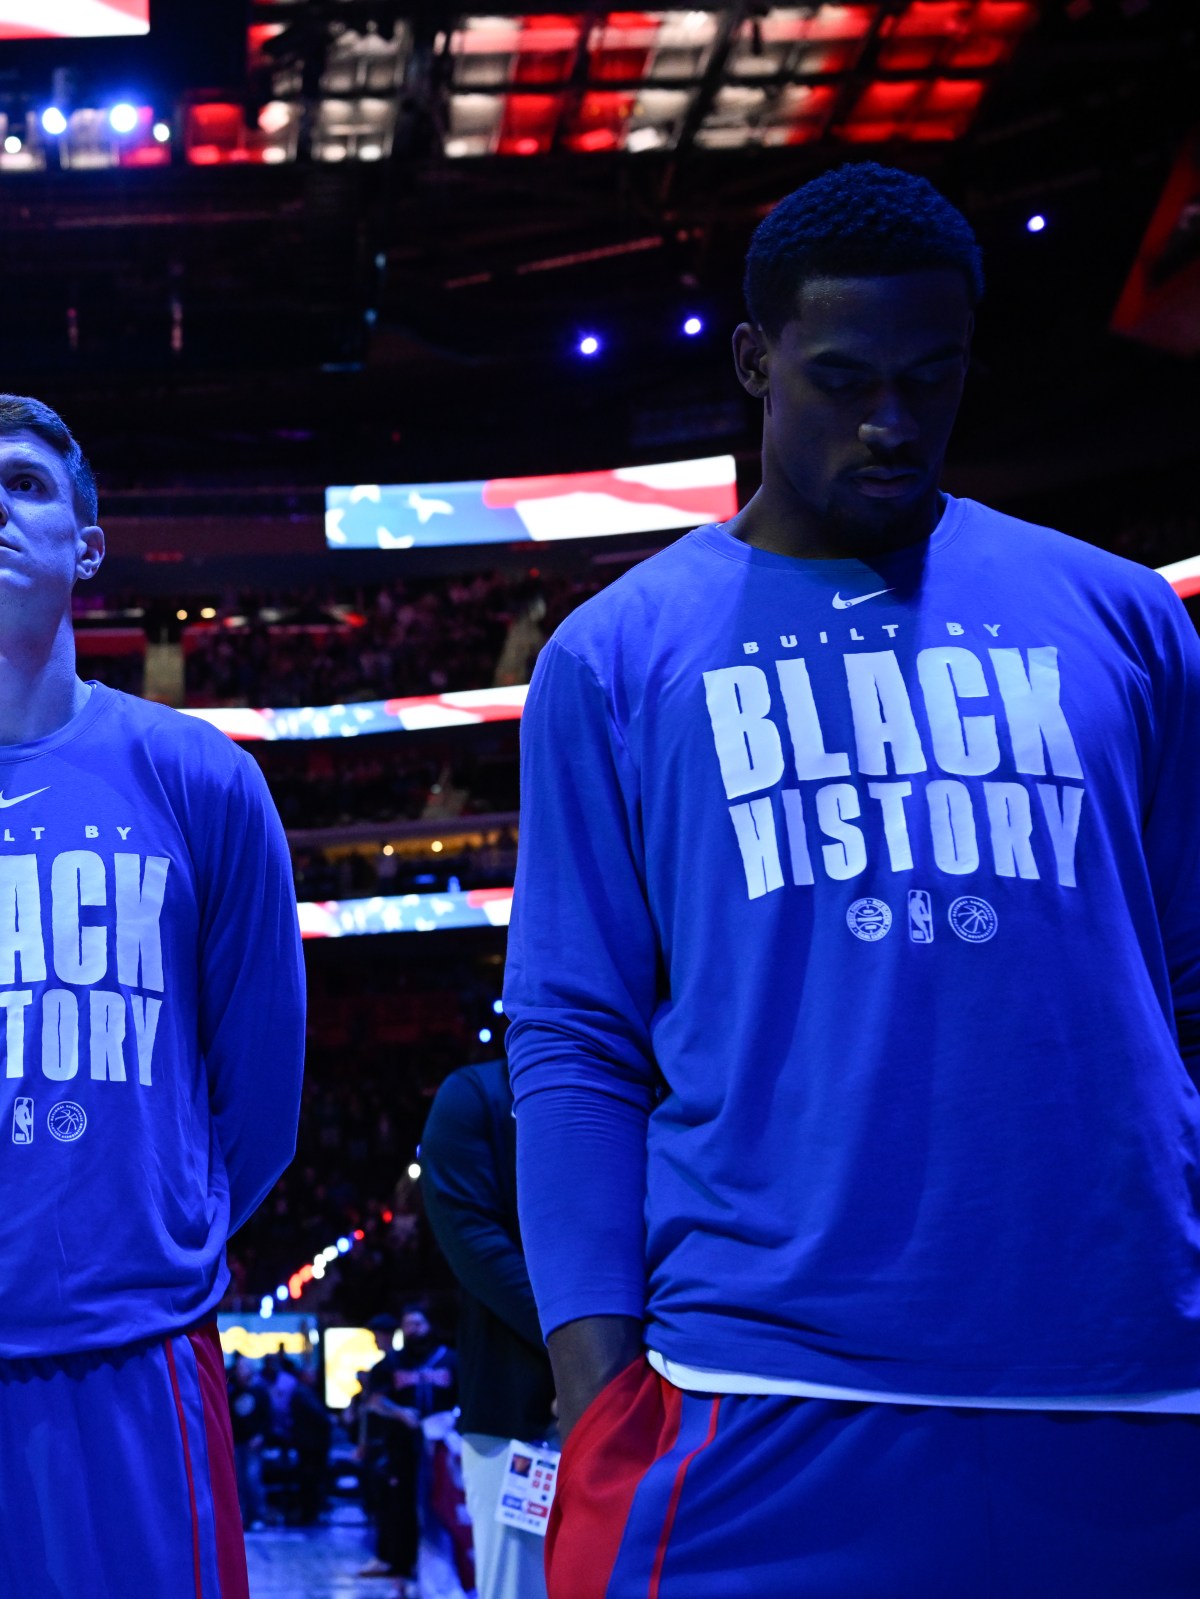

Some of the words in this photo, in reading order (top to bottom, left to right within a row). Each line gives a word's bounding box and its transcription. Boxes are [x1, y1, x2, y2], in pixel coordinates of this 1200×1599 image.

[742, 624, 899, 654] BUILT
[946, 621, 1001, 638] BY
[702, 646, 1085, 800] BLACK
[84, 825, 132, 841] BY
[728, 779, 1086, 900] HISTORY
